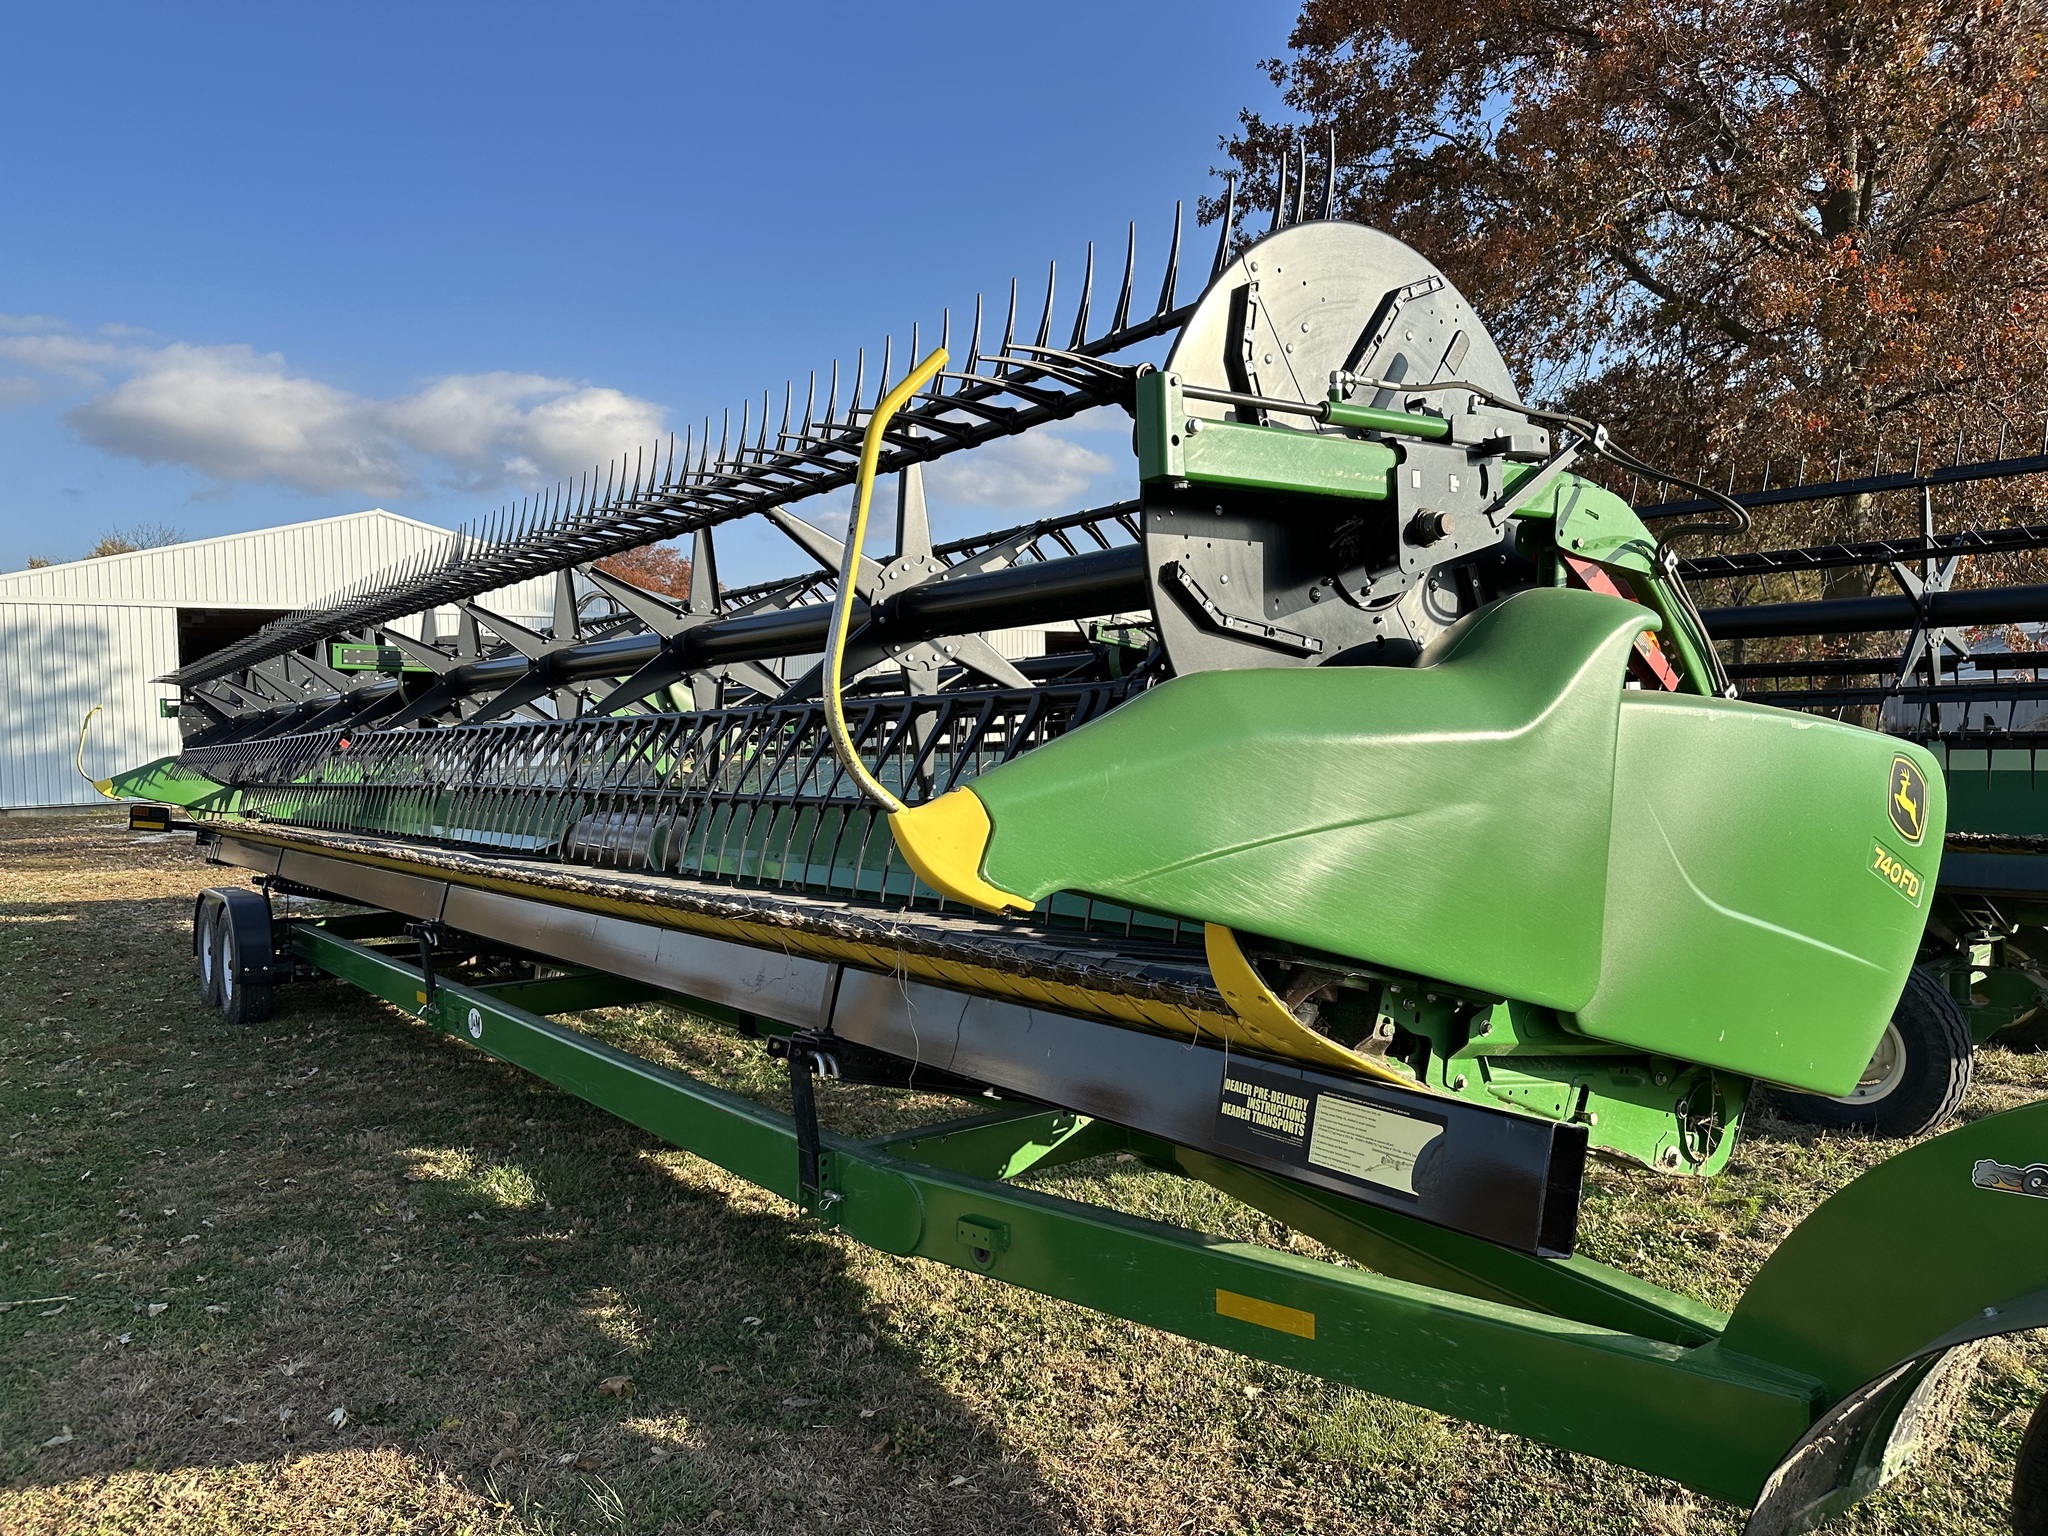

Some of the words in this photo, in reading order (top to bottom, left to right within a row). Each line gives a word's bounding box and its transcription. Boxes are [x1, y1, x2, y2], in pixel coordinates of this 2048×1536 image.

[1873, 845, 1920, 898] 740FD
[1224, 1078, 1253, 1096] DEALER
[1252, 1085, 1310, 1111] PRE-DELIVERY
[1246, 1096, 1307, 1124] INSTRUCTIONS
[1221, 1102, 1251, 1121] HEADER
[1251, 1110, 1305, 1137] TRANSPORTS
